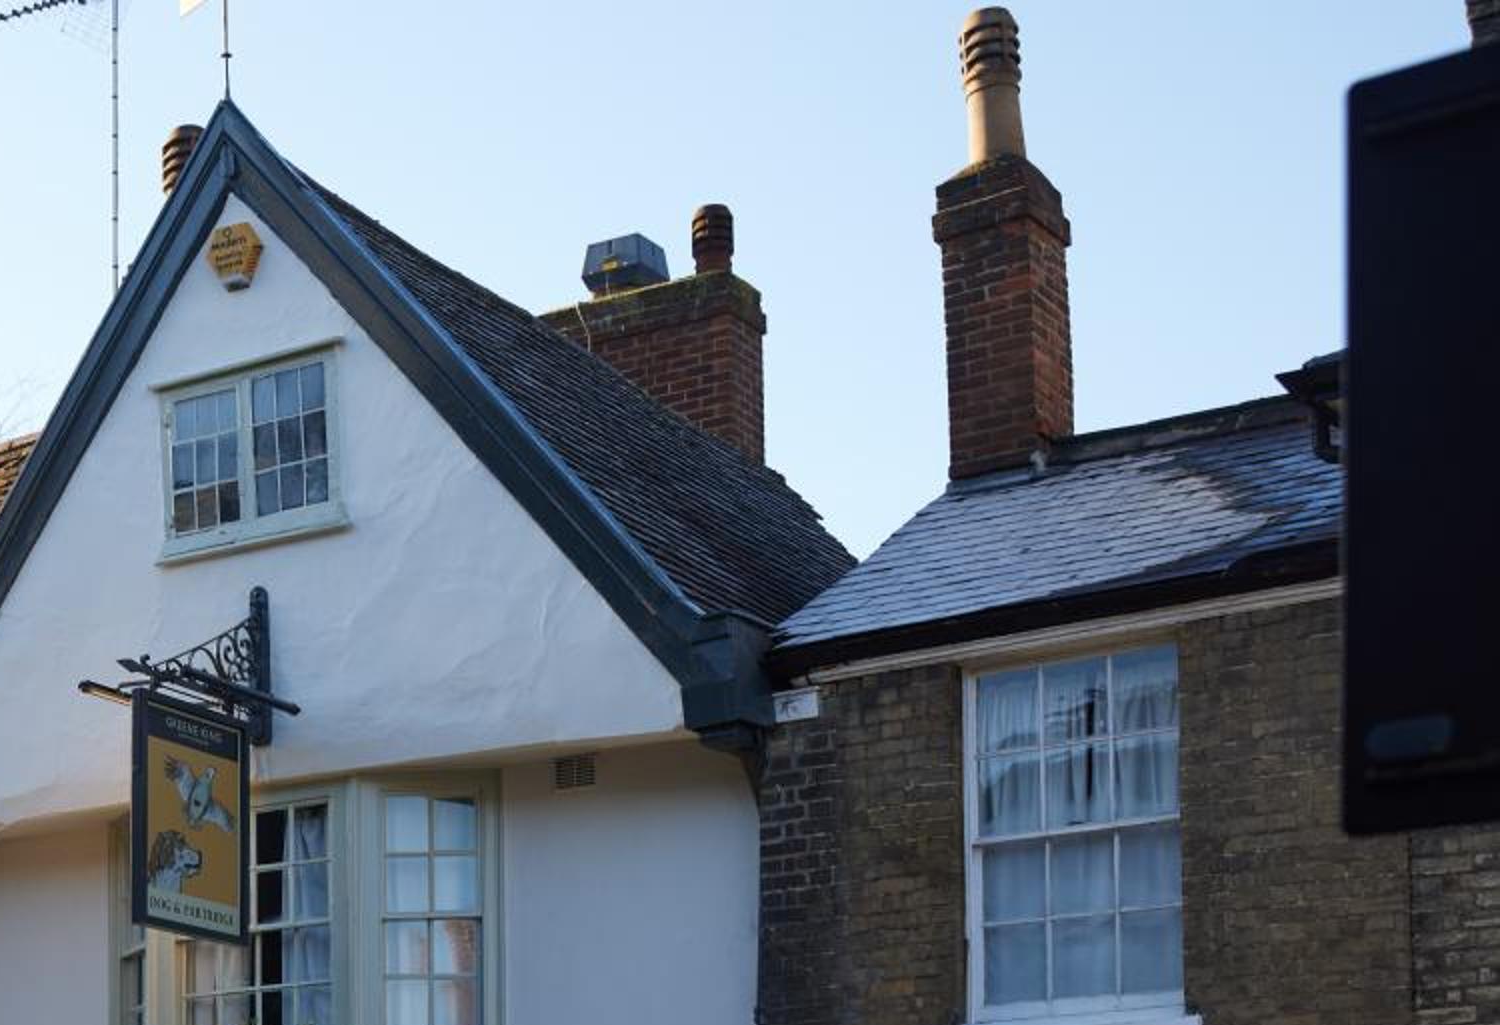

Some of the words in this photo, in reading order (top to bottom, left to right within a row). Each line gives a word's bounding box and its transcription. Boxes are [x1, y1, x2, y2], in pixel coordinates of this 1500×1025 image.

[166, 716, 199, 735] GREENE
[149, 896, 172, 912] DOG
[173, 903, 181, 914] &
[183, 903, 233, 925] PARTRIDGE
